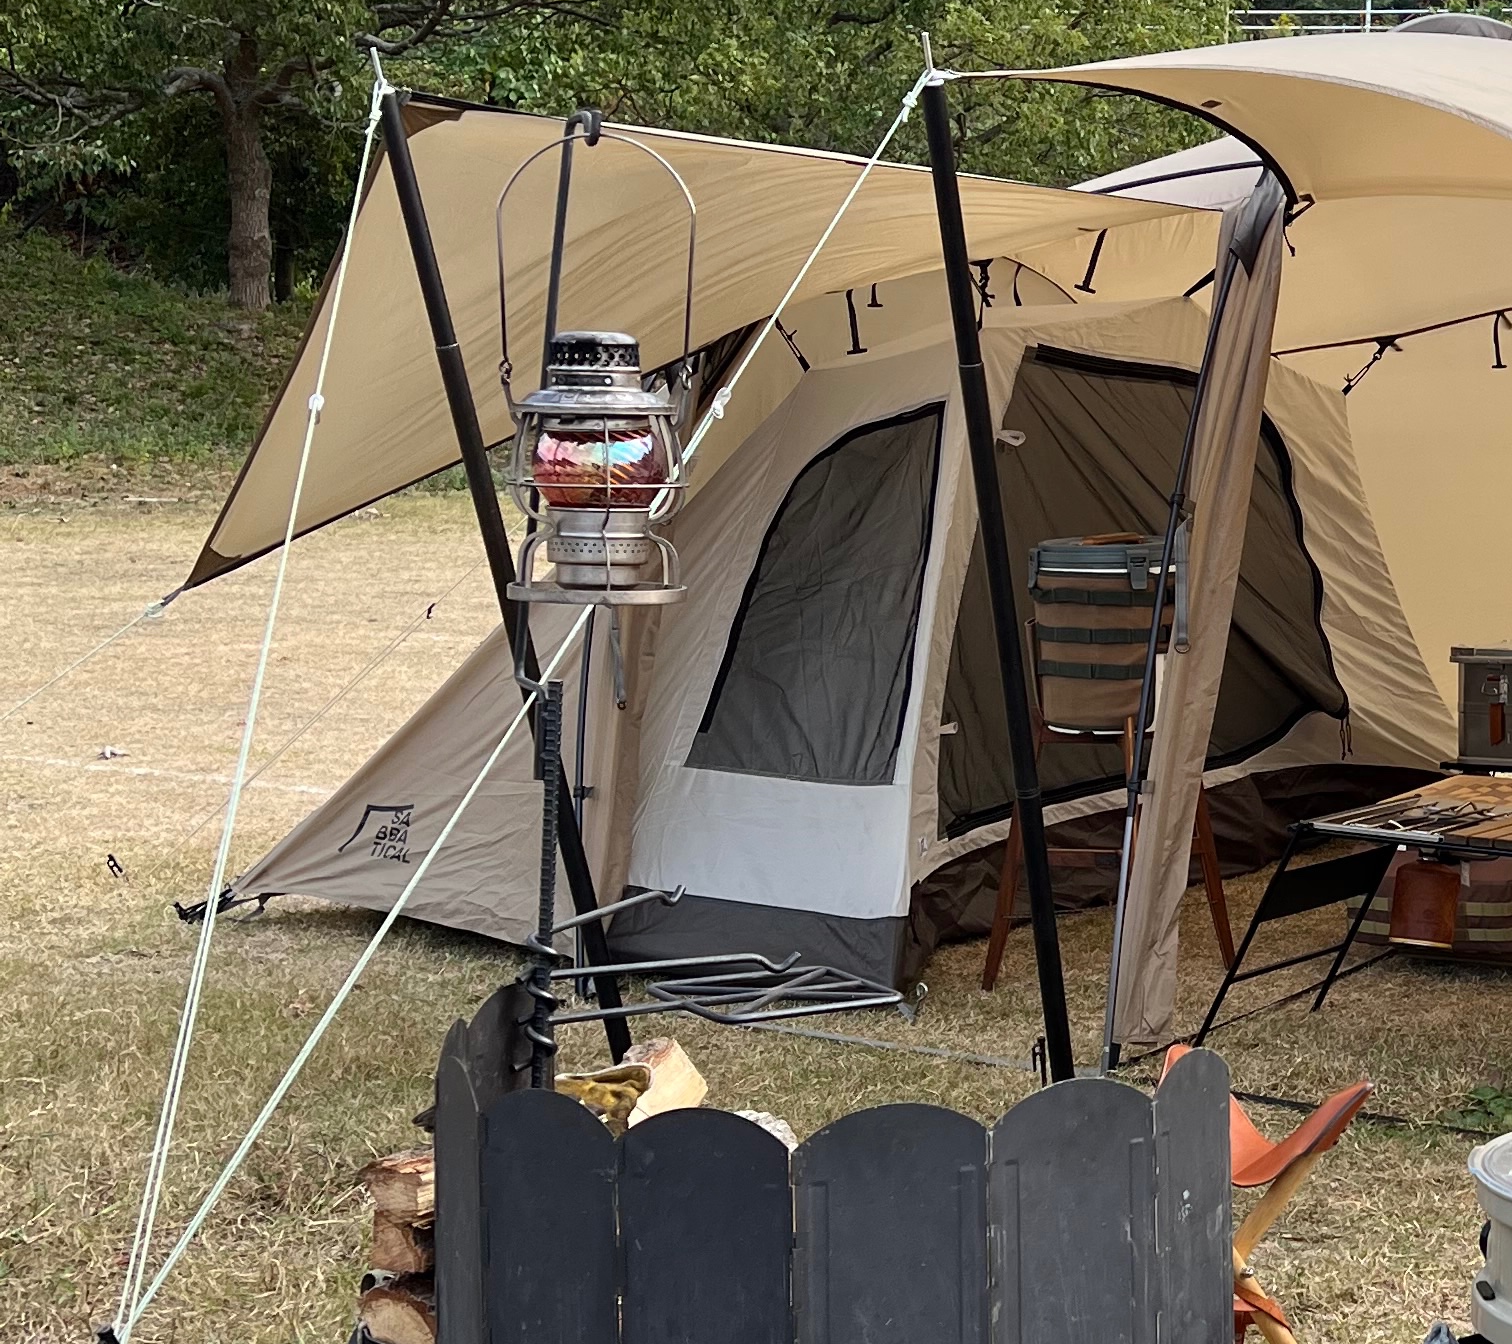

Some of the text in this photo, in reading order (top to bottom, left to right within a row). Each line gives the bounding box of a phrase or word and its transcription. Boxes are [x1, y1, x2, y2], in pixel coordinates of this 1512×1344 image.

[391, 810, 411, 827] SA
[375, 825, 408, 844] BBA
[370, 841, 411, 863] TICAL
